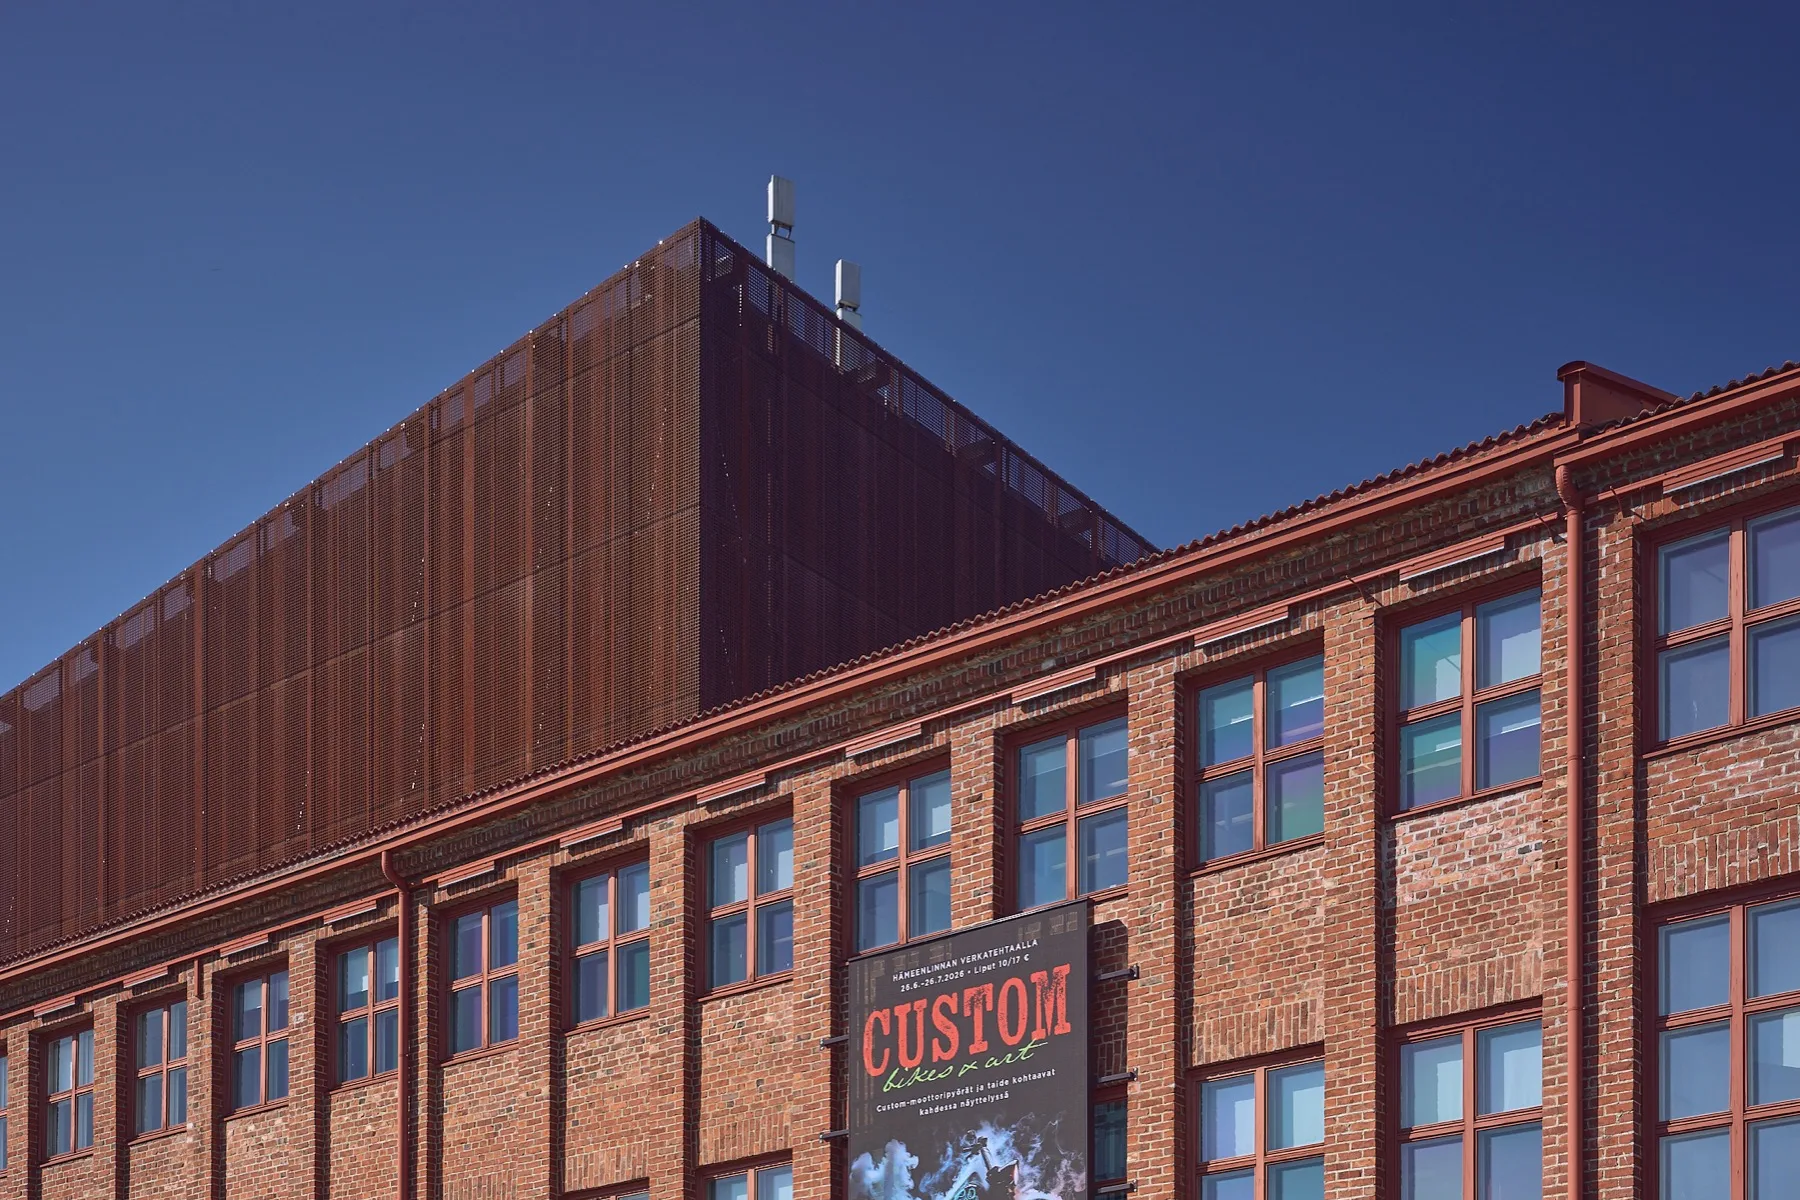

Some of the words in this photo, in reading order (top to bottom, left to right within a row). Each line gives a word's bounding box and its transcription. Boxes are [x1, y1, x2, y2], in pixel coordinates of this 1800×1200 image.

[892, 959, 958, 982] HÄMEENLINNAN
[960, 939, 1038, 964] VERKATEHTAALLA
[974, 962, 996, 974] Liput
[998, 955, 1021, 968] 10/17
[862, 963, 1072, 1077] CUSTOM
[882, 1065, 953, 1093] bikes
[984, 1038, 1048, 1068] art
[876, 1086, 974, 1113] Custom-moottoripyörät
[976, 1084, 984, 1093] ja
[987, 1079, 1009, 1090] taide
[1012, 1068, 1056, 1084] kohtaavat
[919, 1103, 957, 1116] kahdessa
[960, 1091, 1009, 1108] näyttelyssä
